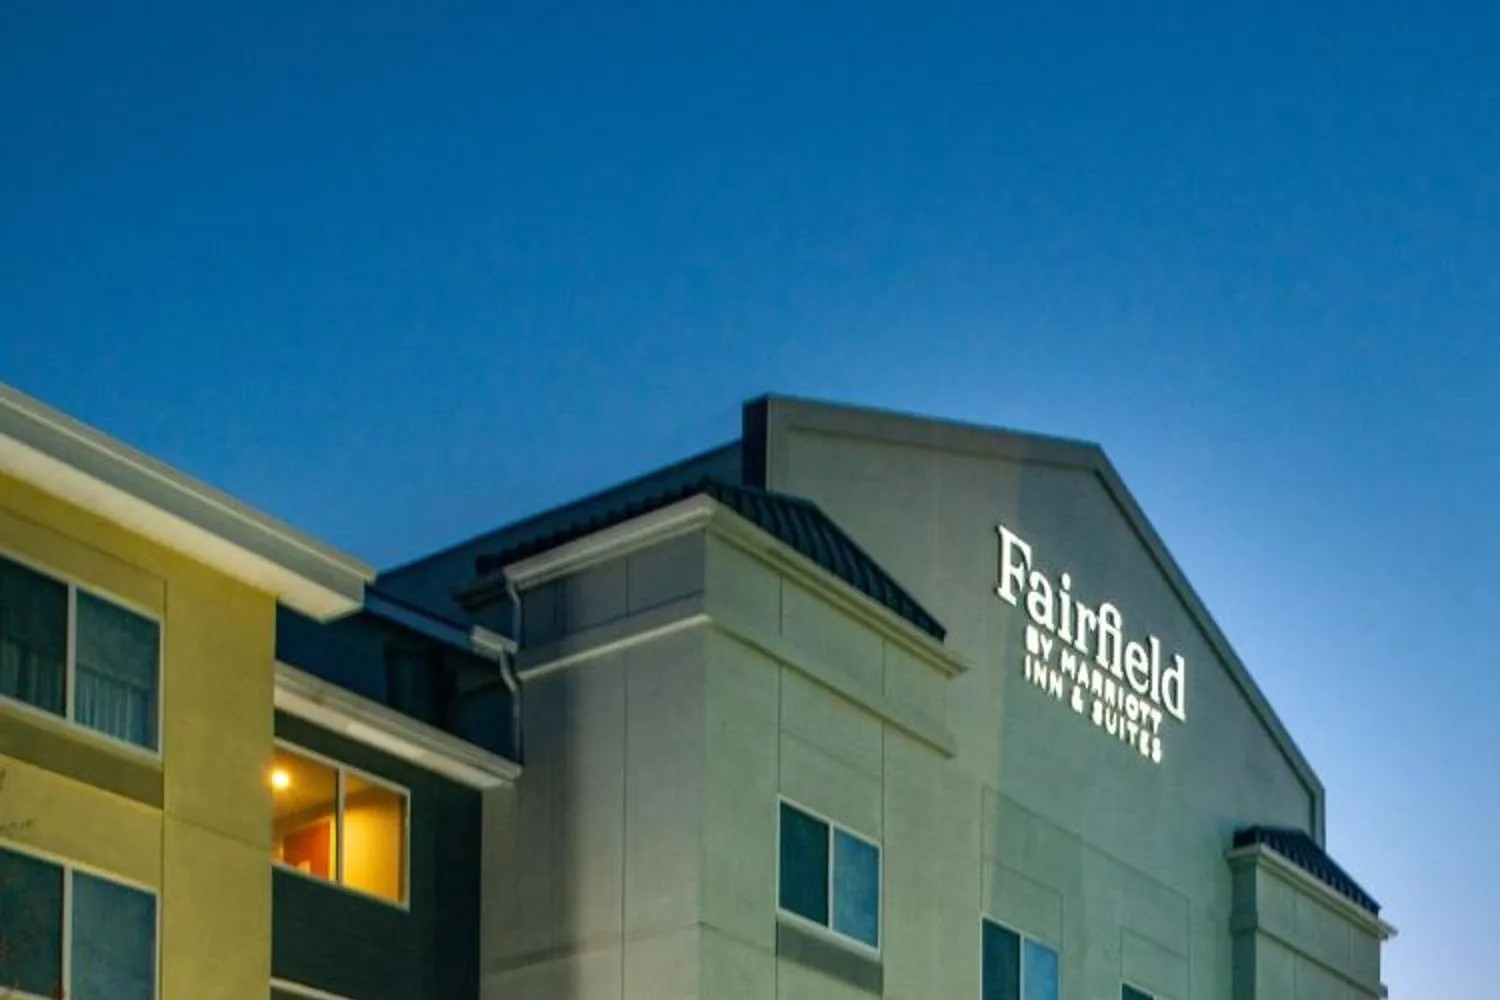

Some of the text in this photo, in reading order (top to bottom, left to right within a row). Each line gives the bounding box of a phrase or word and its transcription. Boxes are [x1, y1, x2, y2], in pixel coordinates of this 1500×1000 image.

[997, 525, 1186, 722] Fairfield
[1025, 655, 1162, 764] INN & SUITES
[1026, 624, 1162, 734] BY MARRIOTT
